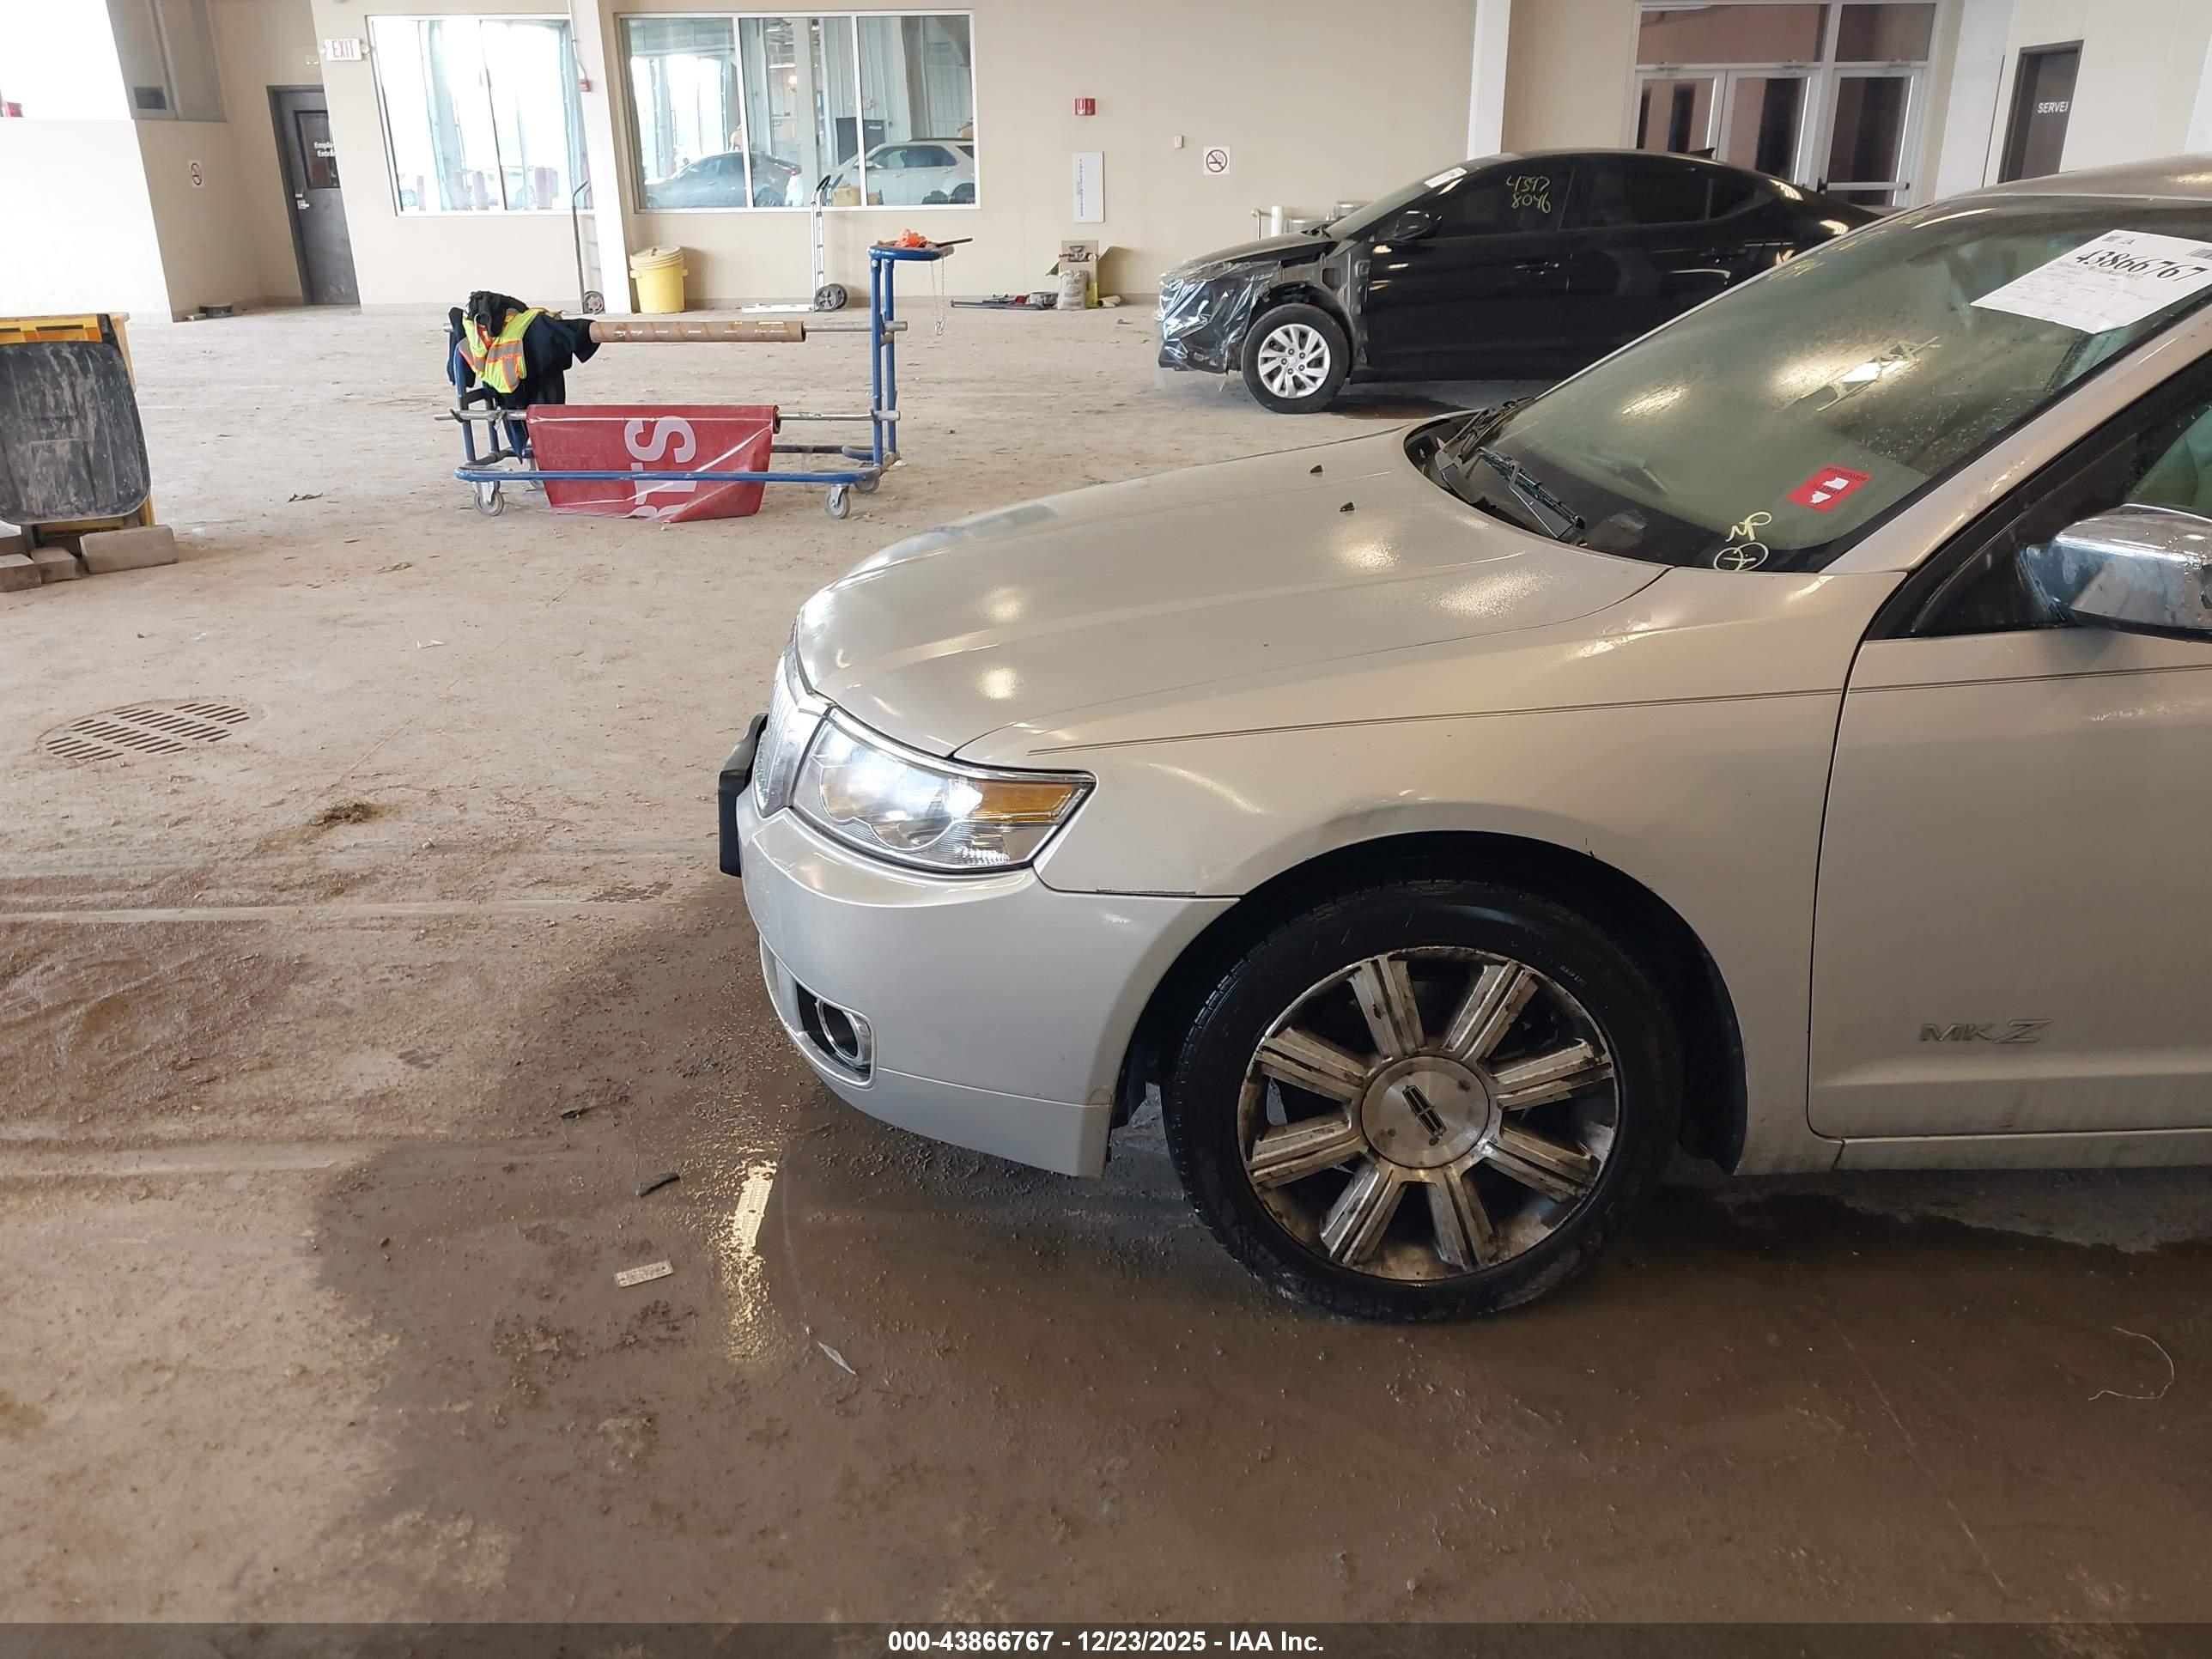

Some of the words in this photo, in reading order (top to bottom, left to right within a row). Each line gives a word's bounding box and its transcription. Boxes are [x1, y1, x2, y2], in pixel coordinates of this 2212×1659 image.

[331, 40, 355, 58] EXIT
[1511, 191, 1552, 214] 8046
[2075, 249, 2209, 282] 43866767
[1918, 1018, 2054, 1044] MKZ
